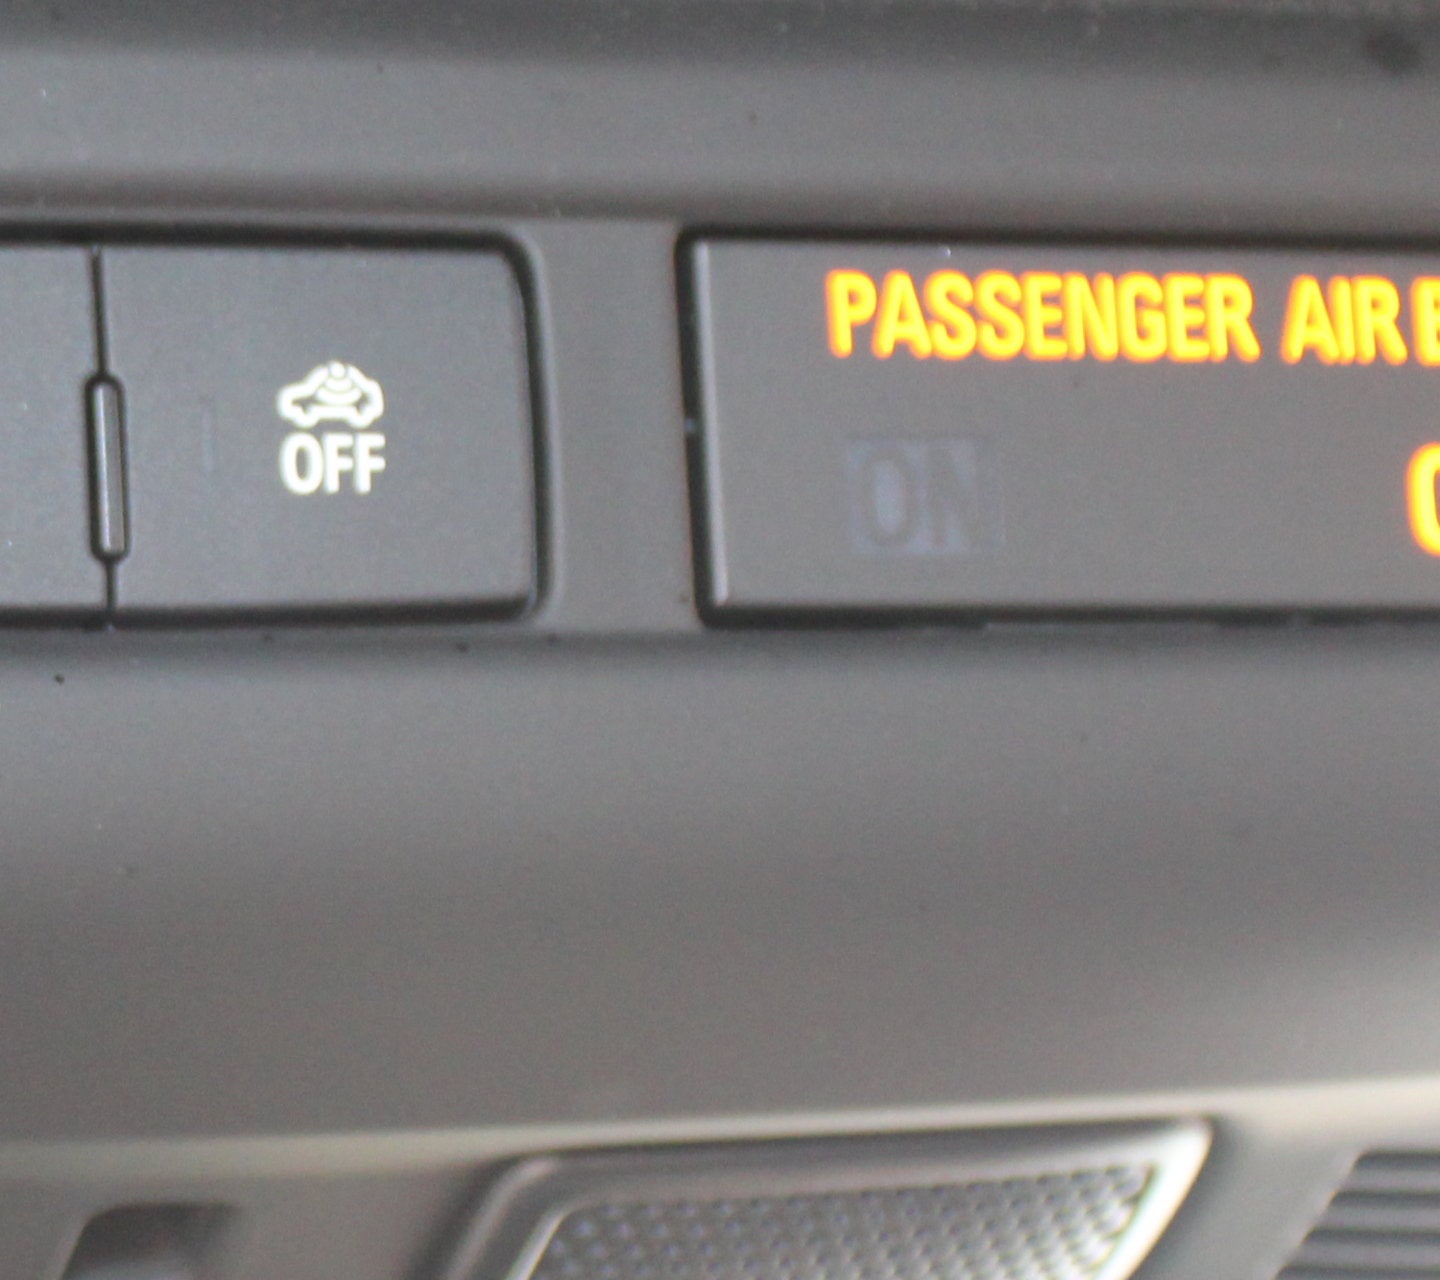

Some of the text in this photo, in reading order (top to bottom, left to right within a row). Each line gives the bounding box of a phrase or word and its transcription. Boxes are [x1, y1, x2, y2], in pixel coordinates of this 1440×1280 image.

[826, 270, 1261, 363] PASSENGER
[1281, 274, 1408, 365] AIR
[278, 432, 386, 496] OFF
